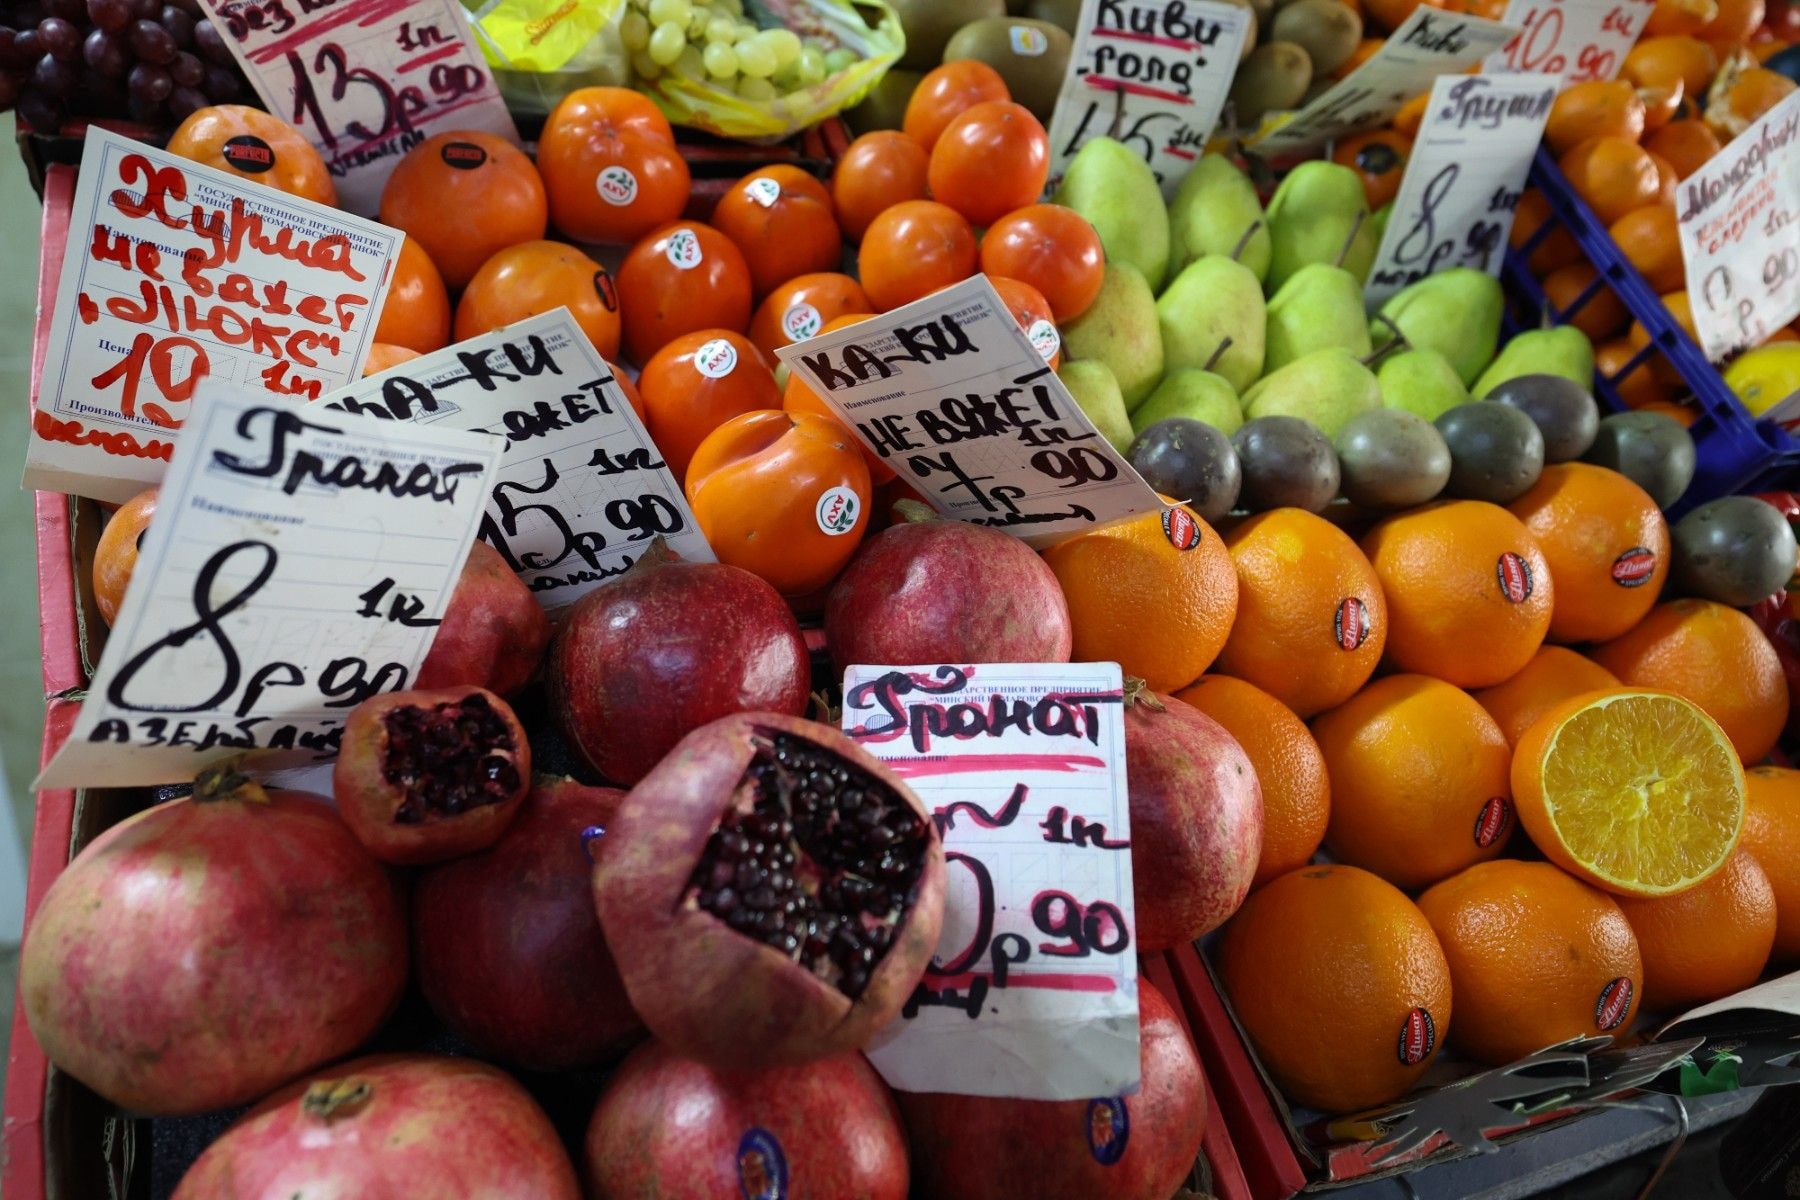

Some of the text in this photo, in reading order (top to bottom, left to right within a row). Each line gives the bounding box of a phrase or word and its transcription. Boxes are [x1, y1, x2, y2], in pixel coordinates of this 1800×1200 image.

[603, 182, 627, 198] AXV
[707, 348, 728, 371] AXV
[801, 315, 980, 390] КА-КИ
[843, 390, 907, 411] Наименование
[857, 415, 925, 457] НЕ
[605, 495, 684, 541] 90
[827, 495, 844, 525] AXV
[1343, 599, 1359, 649] Llusar
[878, 754, 948, 763] аименование
[1030, 889, 1130, 958] 90
[1599, 978, 1630, 1030] Llusar
[1407, 1013, 1423, 1064] Llusar
